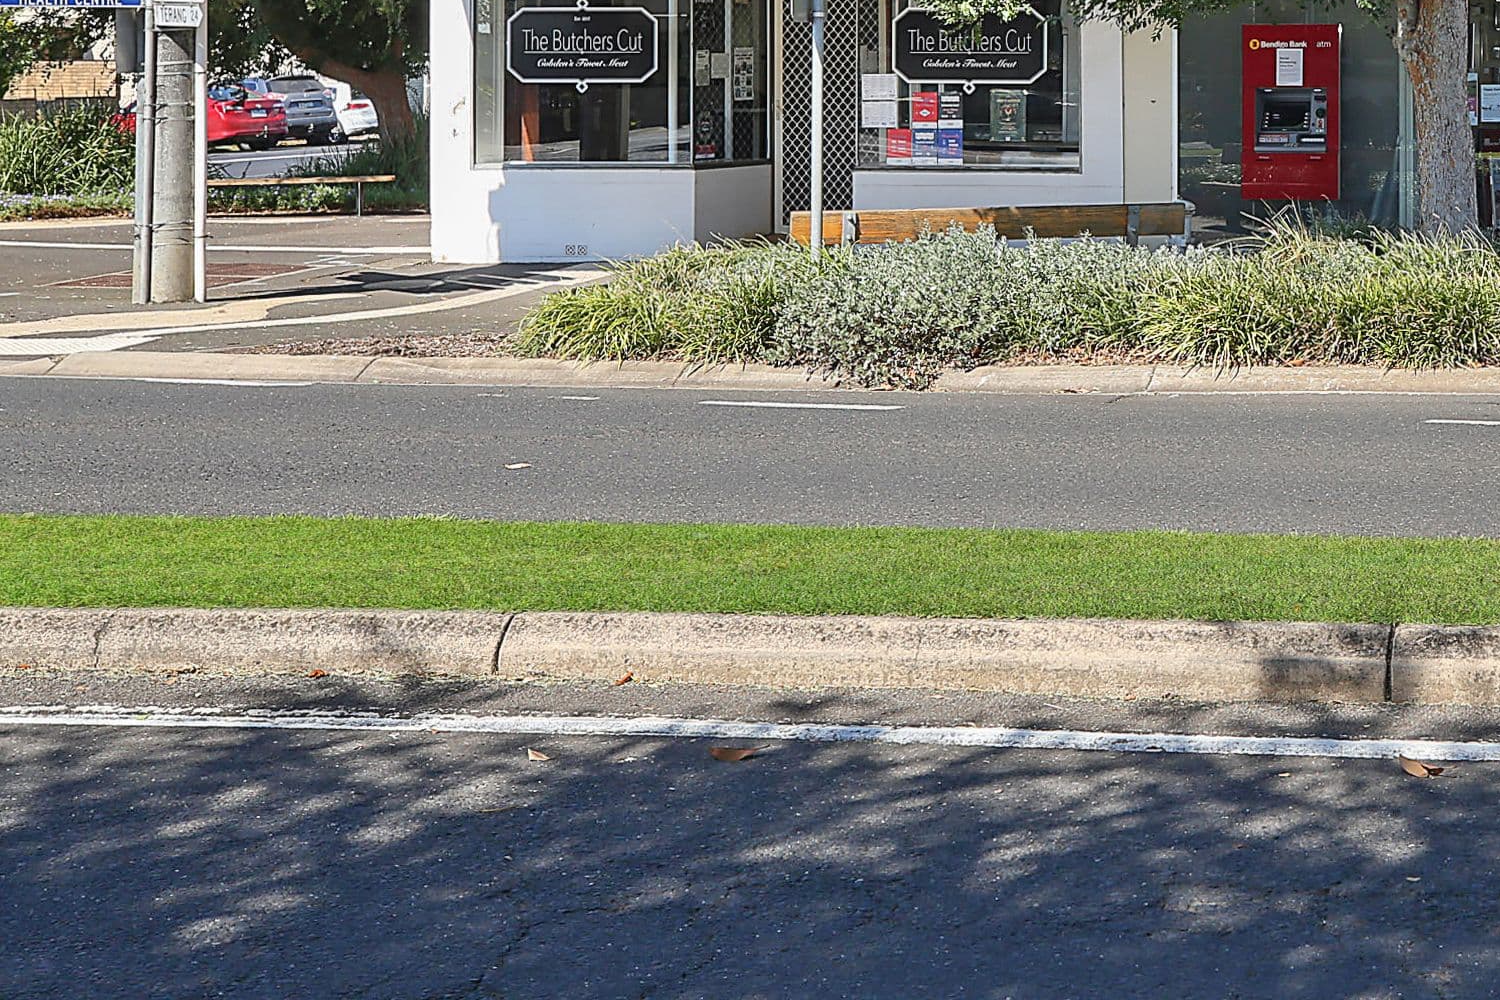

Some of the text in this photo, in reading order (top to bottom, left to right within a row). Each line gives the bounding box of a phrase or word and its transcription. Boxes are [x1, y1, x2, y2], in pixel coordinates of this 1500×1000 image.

[160, 7, 187, 24] TERANG
[522, 28, 643, 52] The Butchers Cut
[907, 28, 1032, 52] The Butchers Cut
[1260, 40, 1289, 49] Bendigo
[537, 58, 630, 68] Cobden's Finest Meat
[922, 59, 961, 68] Cobden's
[961, 59, 990, 68] Finest
